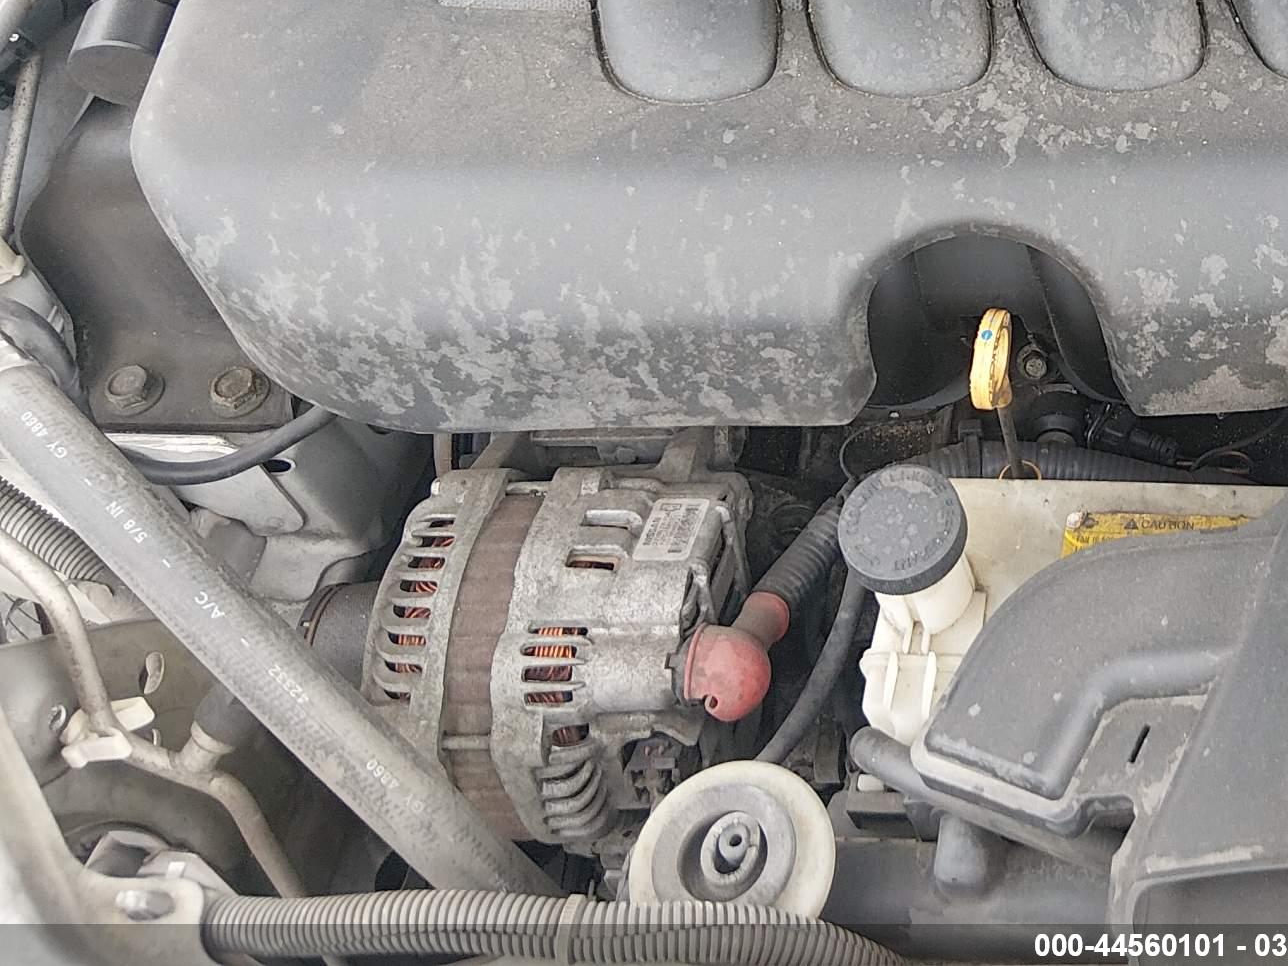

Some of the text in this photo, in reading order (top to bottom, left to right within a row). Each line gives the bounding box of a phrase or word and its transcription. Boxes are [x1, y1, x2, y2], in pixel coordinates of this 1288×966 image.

[45, 440, 68, 459] GY
[105, 500, 124, 519] IN
[122, 518, 148, 544] 5/8
[194, 590, 226, 619] A/C
